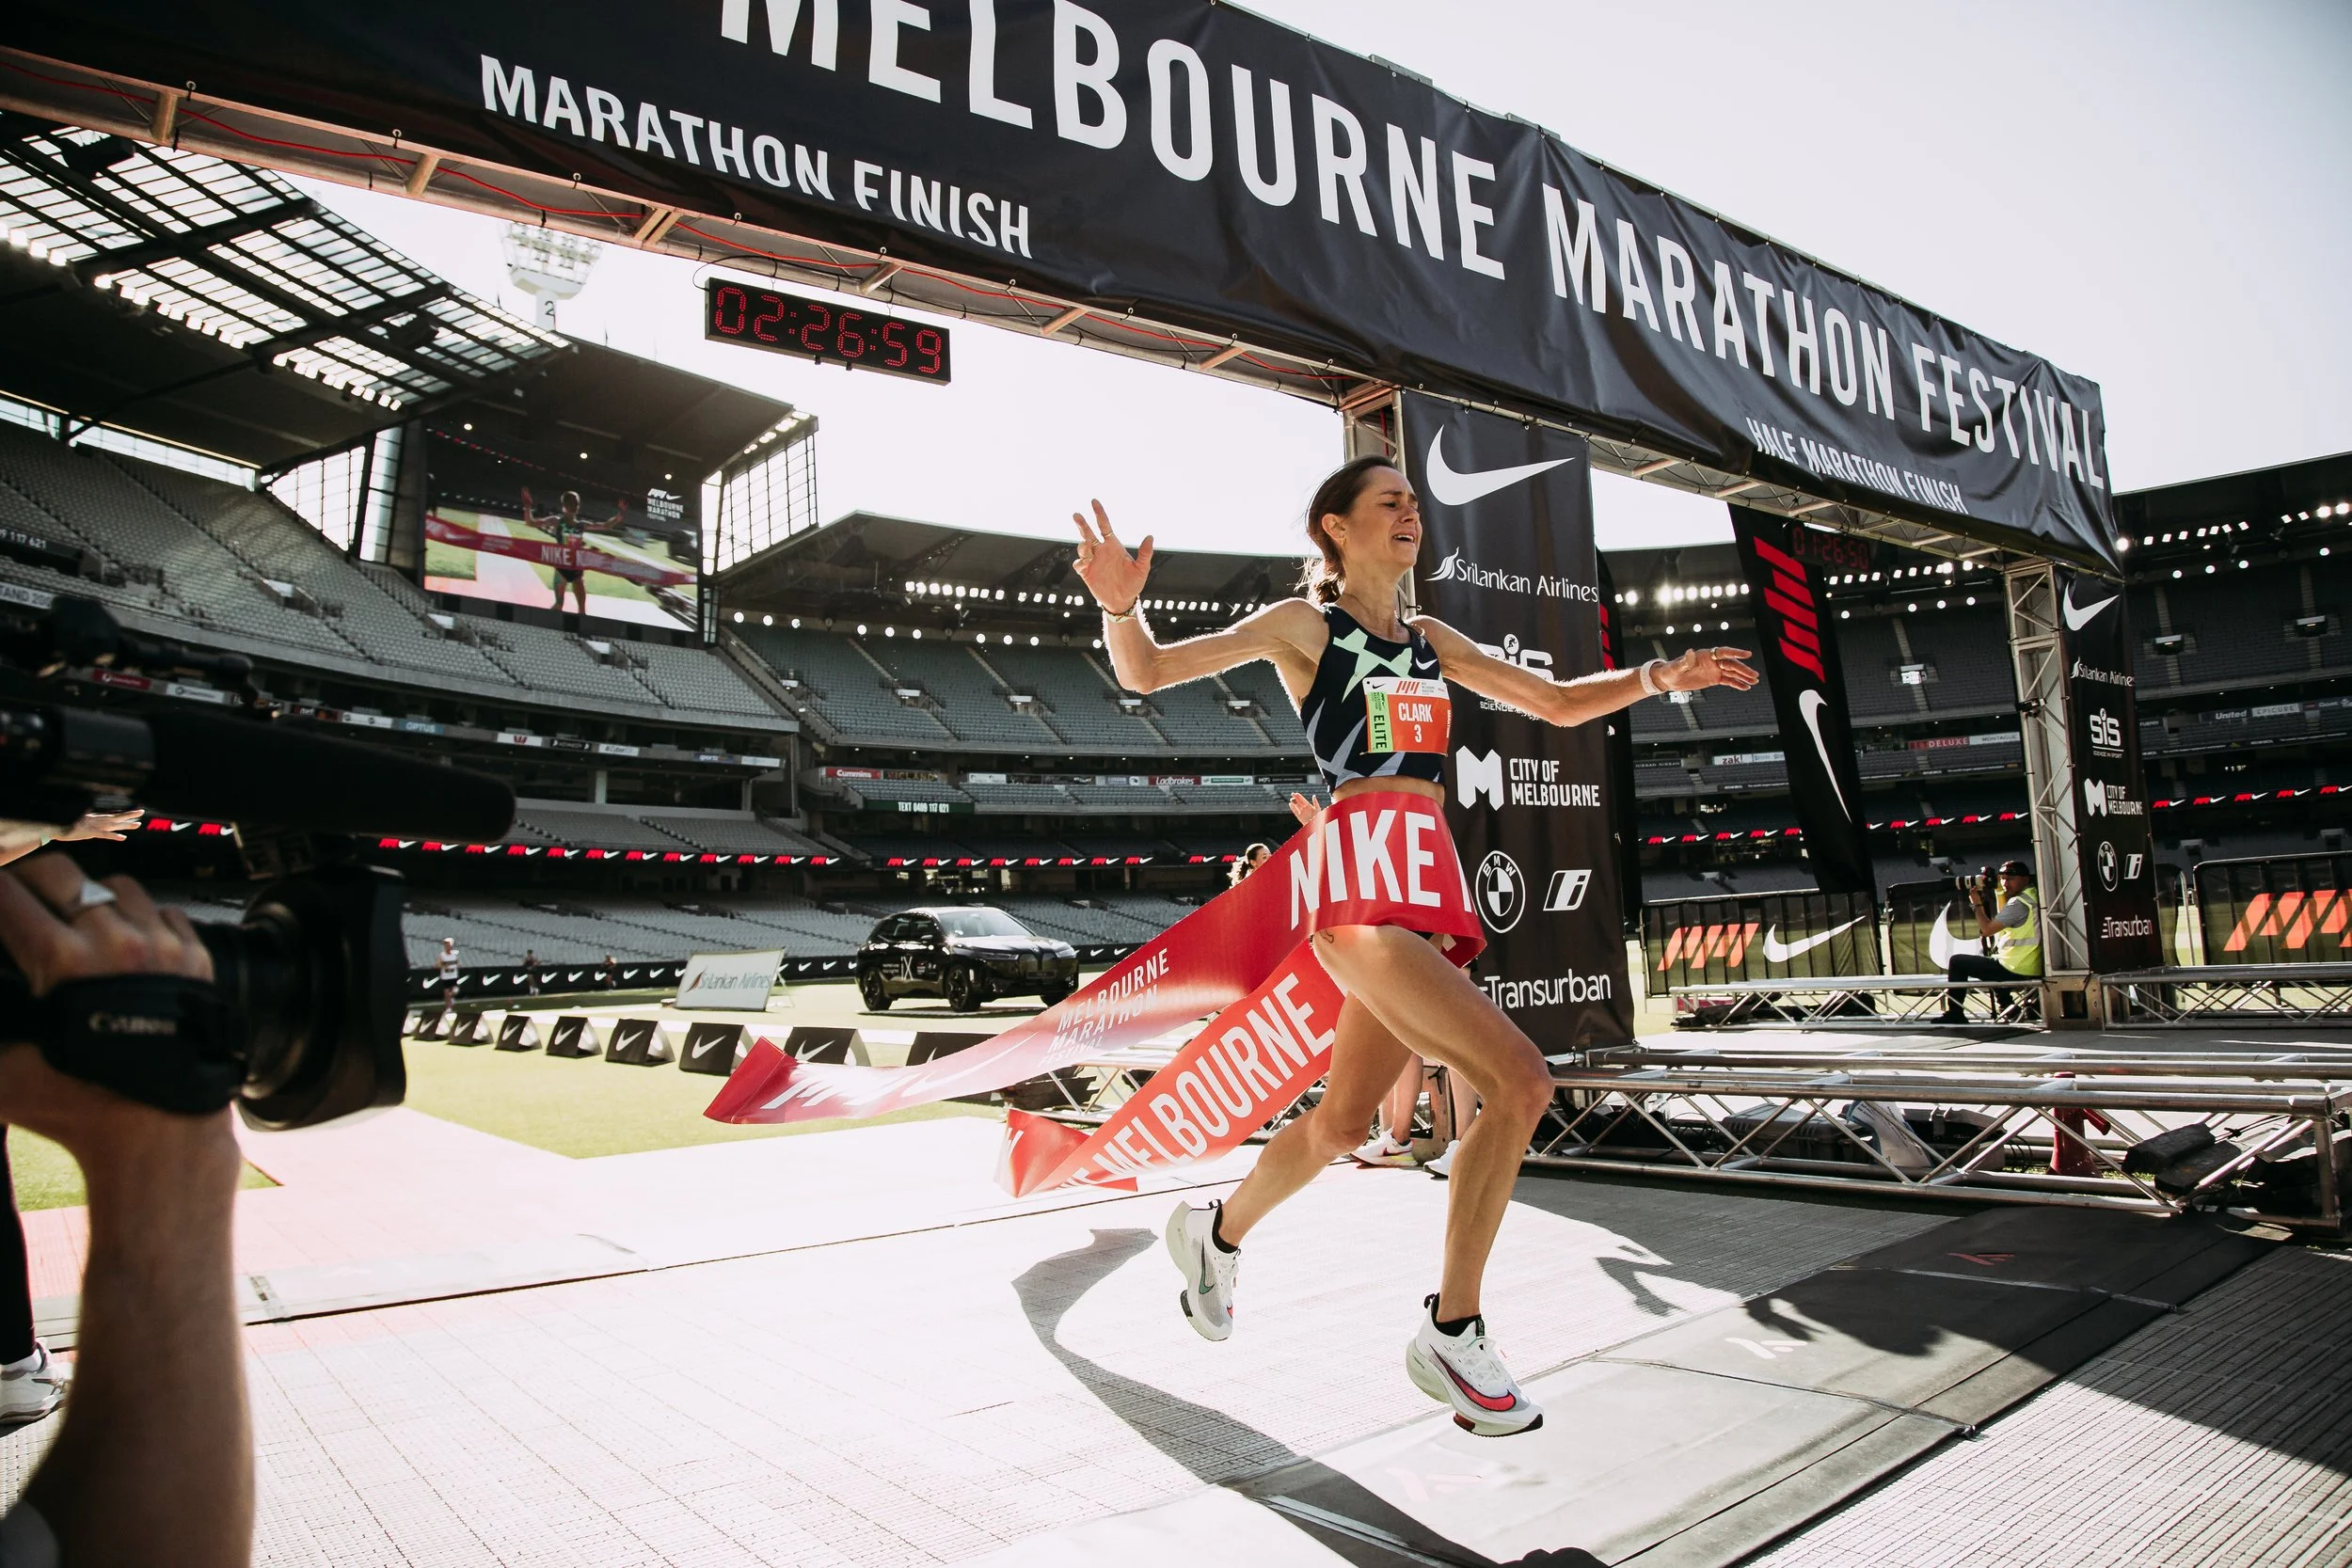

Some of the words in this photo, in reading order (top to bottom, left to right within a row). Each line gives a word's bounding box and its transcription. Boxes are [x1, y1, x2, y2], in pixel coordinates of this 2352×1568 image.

[481, 55, 834, 201] MARATHON
[853, 159, 1033, 259] FINISH
[545, 300, 555, 317] 2
[715, 287, 941, 374] 02:26:59
[1542, 182, 1895, 421] MARATHON
[1912, 341, 2104, 490] FESTIVAL
[1746, 417, 1799, 465] HALF
[1800, 436, 1909, 499] MARATHON
[1903, 470, 1969, 515] FINISH
[542, 545, 571, 565] NIKE
[1455, 558, 1531, 594] SriLankan
[1536, 575, 1598, 603] Airlines
[1398, 702, 1433, 722] CLARK
[2216, 710, 2247, 720] United
[405, 721, 436, 733] OPTUS
[1374, 715, 1388, 749] ELITE
[1414, 723, 1422, 743] 3
[1930, 737, 1969, 748] DELUXE
[836, 769, 872, 779] Cummins
[1156, 777, 1195, 785] Ladbrokes
[1509, 758, 1538, 781] CITY
[1542, 760, 1560, 783] OF
[1511, 783, 1601, 807] MELBOURNE
[2106, 784, 2118, 799] CITY
[2119, 785, 2126, 800] OF
[898, 801, 912, 813] TEXT
[2108, 800, 2143, 815] MELBOURNE
[1290, 810, 1440, 930] NIKE
[1483, 855, 1517, 877] BMW
[2104, 915, 2153, 939] Transurban
[1057, 947, 1169, 1033] MELBOURNE
[1484, 968, 1612, 1010] Transurban
[1047, 984, 1158, 1053] MARATHON
[1092, 972, 1336, 1176] MELBOURNE
